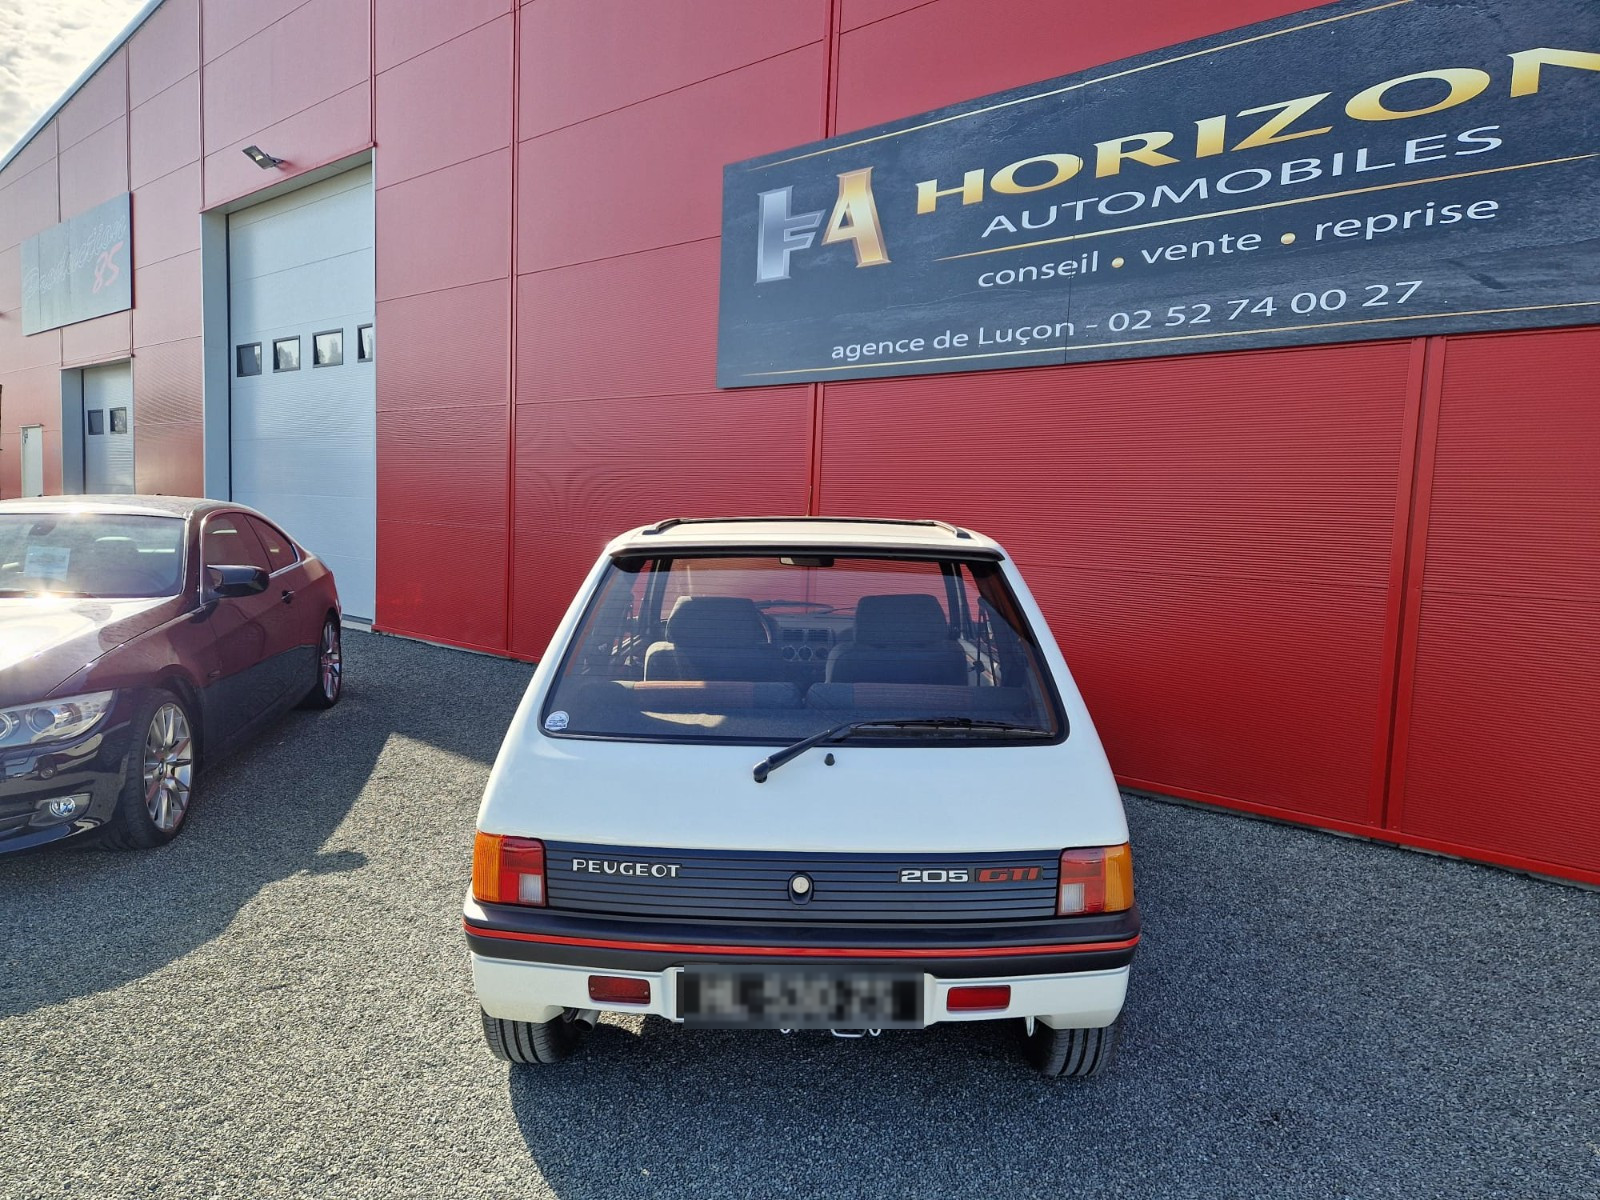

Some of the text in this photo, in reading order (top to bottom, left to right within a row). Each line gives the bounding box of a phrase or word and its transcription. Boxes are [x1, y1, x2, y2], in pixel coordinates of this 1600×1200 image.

[981, 125, 1502, 238] AUTOMOBILES
[978, 200, 1499, 287] conseil vente reprise
[831, 337, 925, 361] agence
[933, 330, 969, 349] de
[978, 321, 1074, 345] Luçon
[1108, 310, 1151, 331] 02
[1165, 303, 1211, 326] 52
[1227, 296, 1277, 320] 74
[1290, 289, 1347, 313] 00
[1362, 280, 1423, 307] 27
[572, 859, 680, 878] PEUGEOT
[901, 867, 1039, 883] 205 GTI
